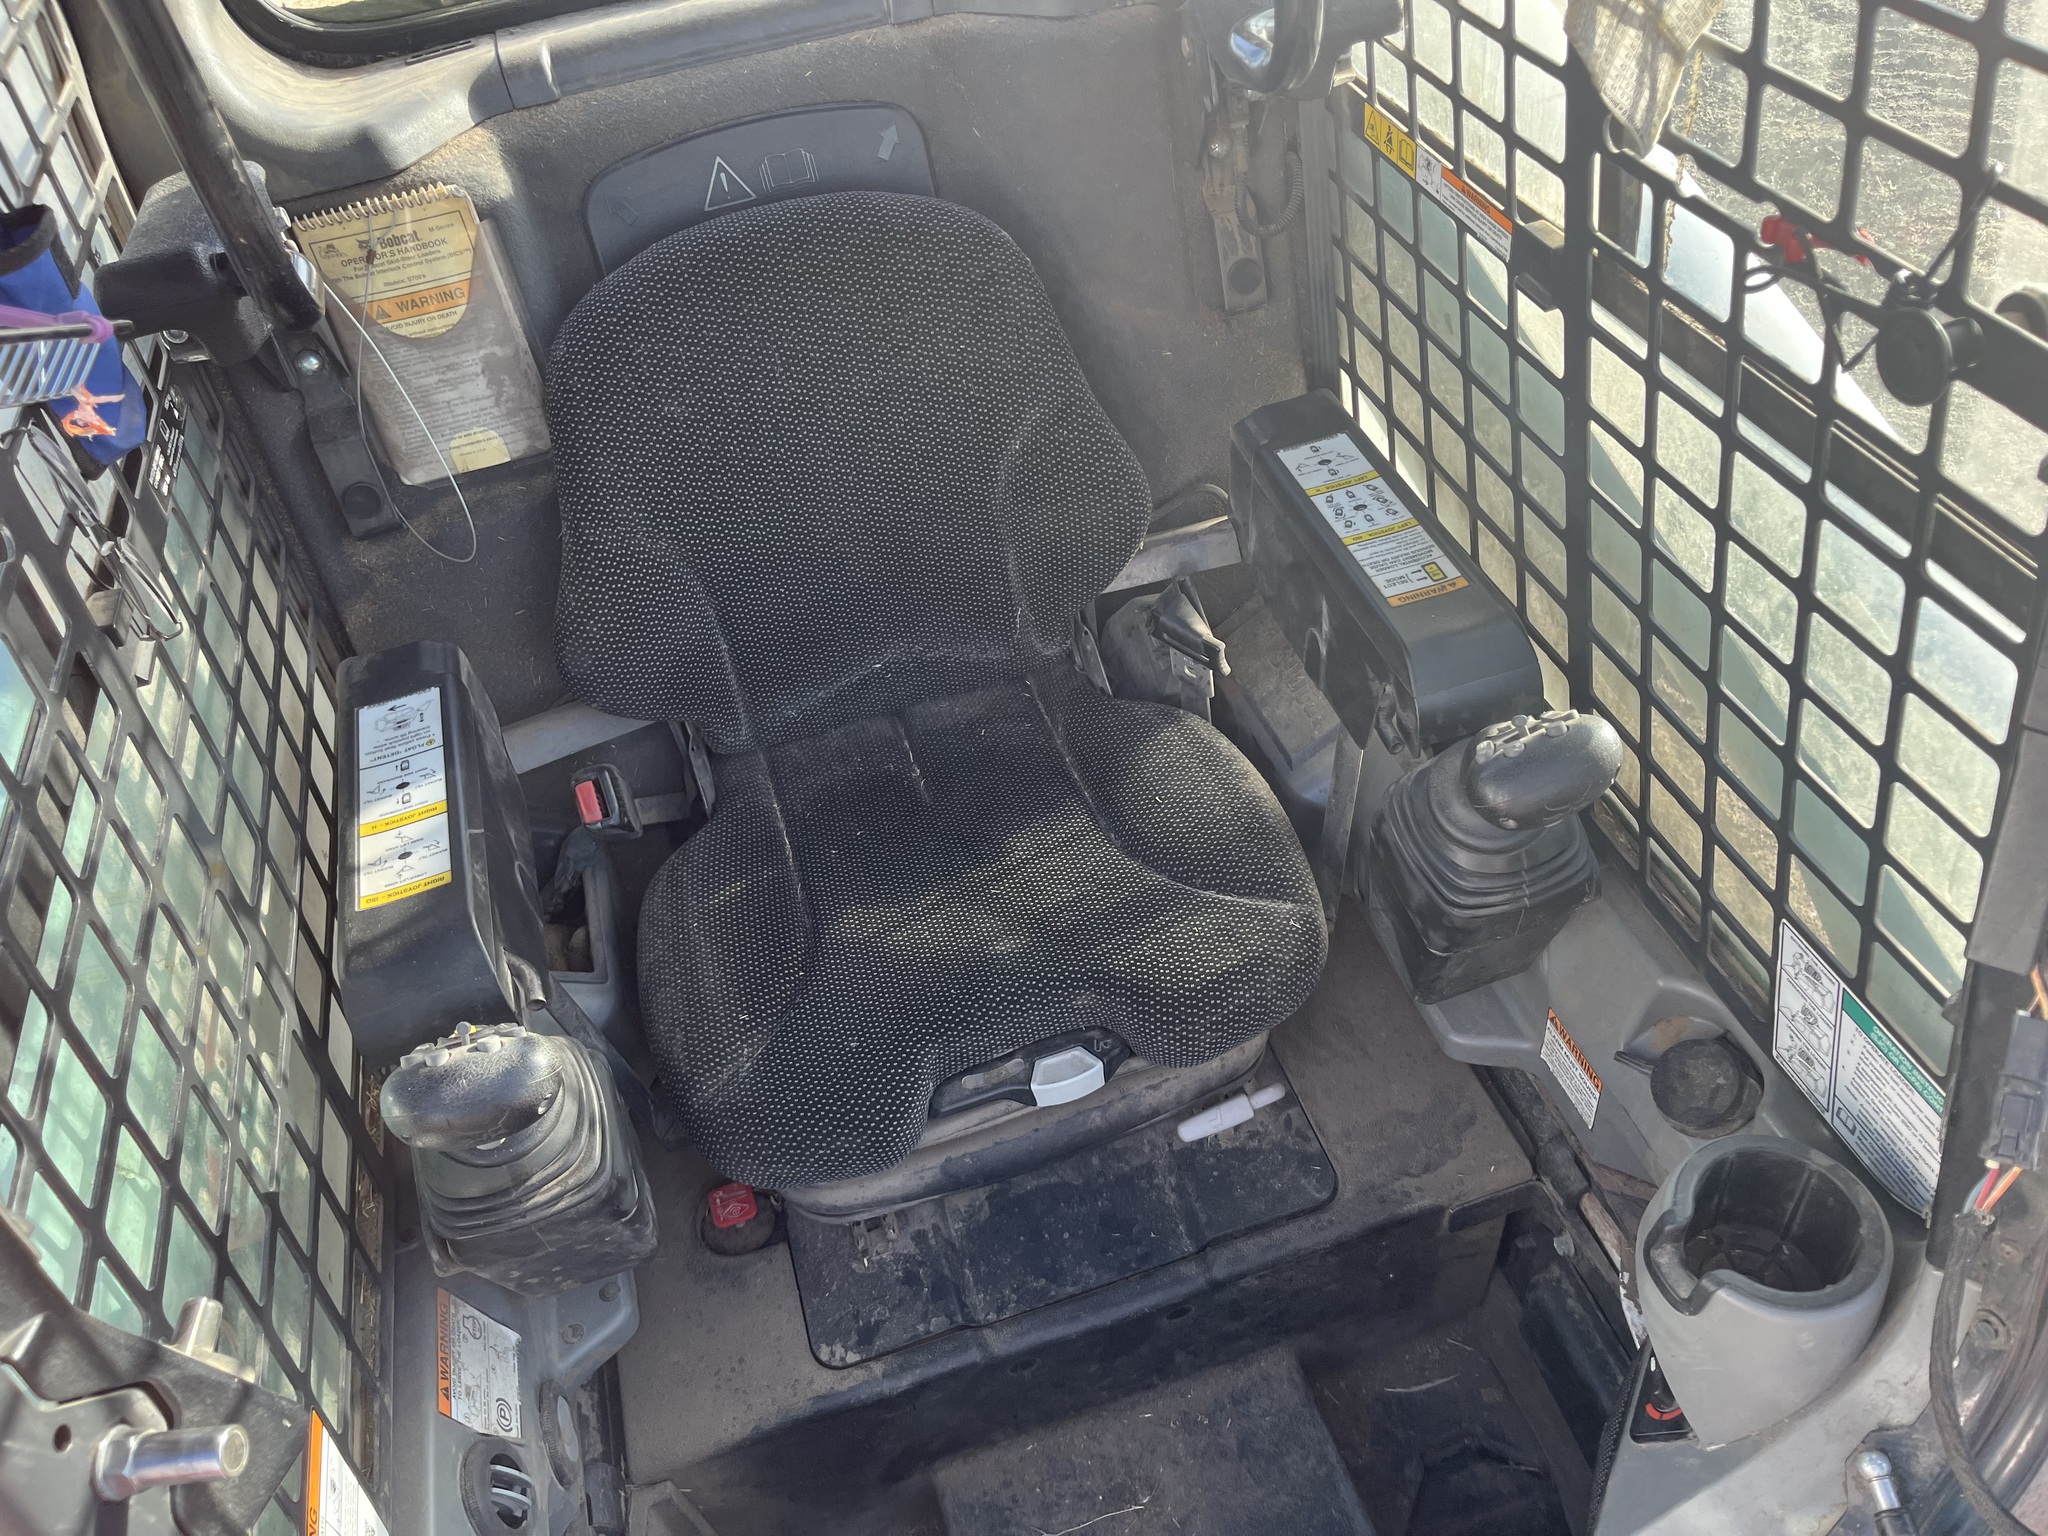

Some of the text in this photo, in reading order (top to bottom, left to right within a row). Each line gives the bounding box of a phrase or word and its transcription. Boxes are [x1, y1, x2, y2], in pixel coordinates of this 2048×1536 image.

[1466, 189, 1490, 213] WARNING
[377, 229, 421, 250] Bobcat
[340, 237, 448, 268] OPEROR'S HANDBOOK
[364, 261, 386, 270] Bbcat
[416, 249, 441, 258] Loaders
[354, 270, 376, 280] Bobat
[375, 264, 402, 275] Interlock
[401, 259, 425, 269] Control
[424, 254, 447, 265] System
[383, 278, 407, 287] Models:
[395, 287, 466, 313] WARNING
[403, 317, 427, 328] INJURY
[437, 310, 458, 320] DEATH
[1324, 479, 1354, 491] JOYSTICK
[1395, 521, 1412, 529] LEFT
[1367, 526, 1396, 537] JOYSTICK
[1401, 549, 1434, 561] MOVEMENT
[1410, 544, 1435, 554] SERIOUS
[1390, 551, 1410, 560] INJURY
[1361, 560, 1381, 568] DEATH
[1369, 562, 1389, 570] CAUSE
[1375, 553, 1433, 573] ACCIDENTAL LOADER
[1382, 578, 1409, 589] SELECT
[1384, 574, 1406, 584] MODE
[1397, 584, 1448, 604] WARNING
[388, 735, 409, 746] joystick
[410, 731, 422, 739] right
[384, 744, 396, 752] float
[397, 738, 414, 747] yellow
[404, 742, 424, 752] FLOAT
[365, 748, 383, 757] button
[418, 806, 437, 816] RIGHT
[385, 812, 416, 827] JOYSTICK
[423, 875, 445, 887] RIGHT
[387, 883, 422, 899] JOYSTICK
[366, 896, 378, 904] ISO
[1547, 1025, 1564, 1052] ALARM
[1564, 1050, 1578, 1072] MUST
[1855, 1027, 1863, 1037] TO
[1864, 1037, 1888, 1067] OPERATE
[1559, 1025, 1600, 1090] WARNING
[1873, 1025, 1944, 1105] OPERATION INSTRUC
[1888, 1050, 1899, 1065] OR
[1923, 1088, 1943, 1113] CONT
[441, 1303, 449, 1382] WARNING
[457, 1390, 462, 1401] TO
[500, 1407, 509, 1422] P
